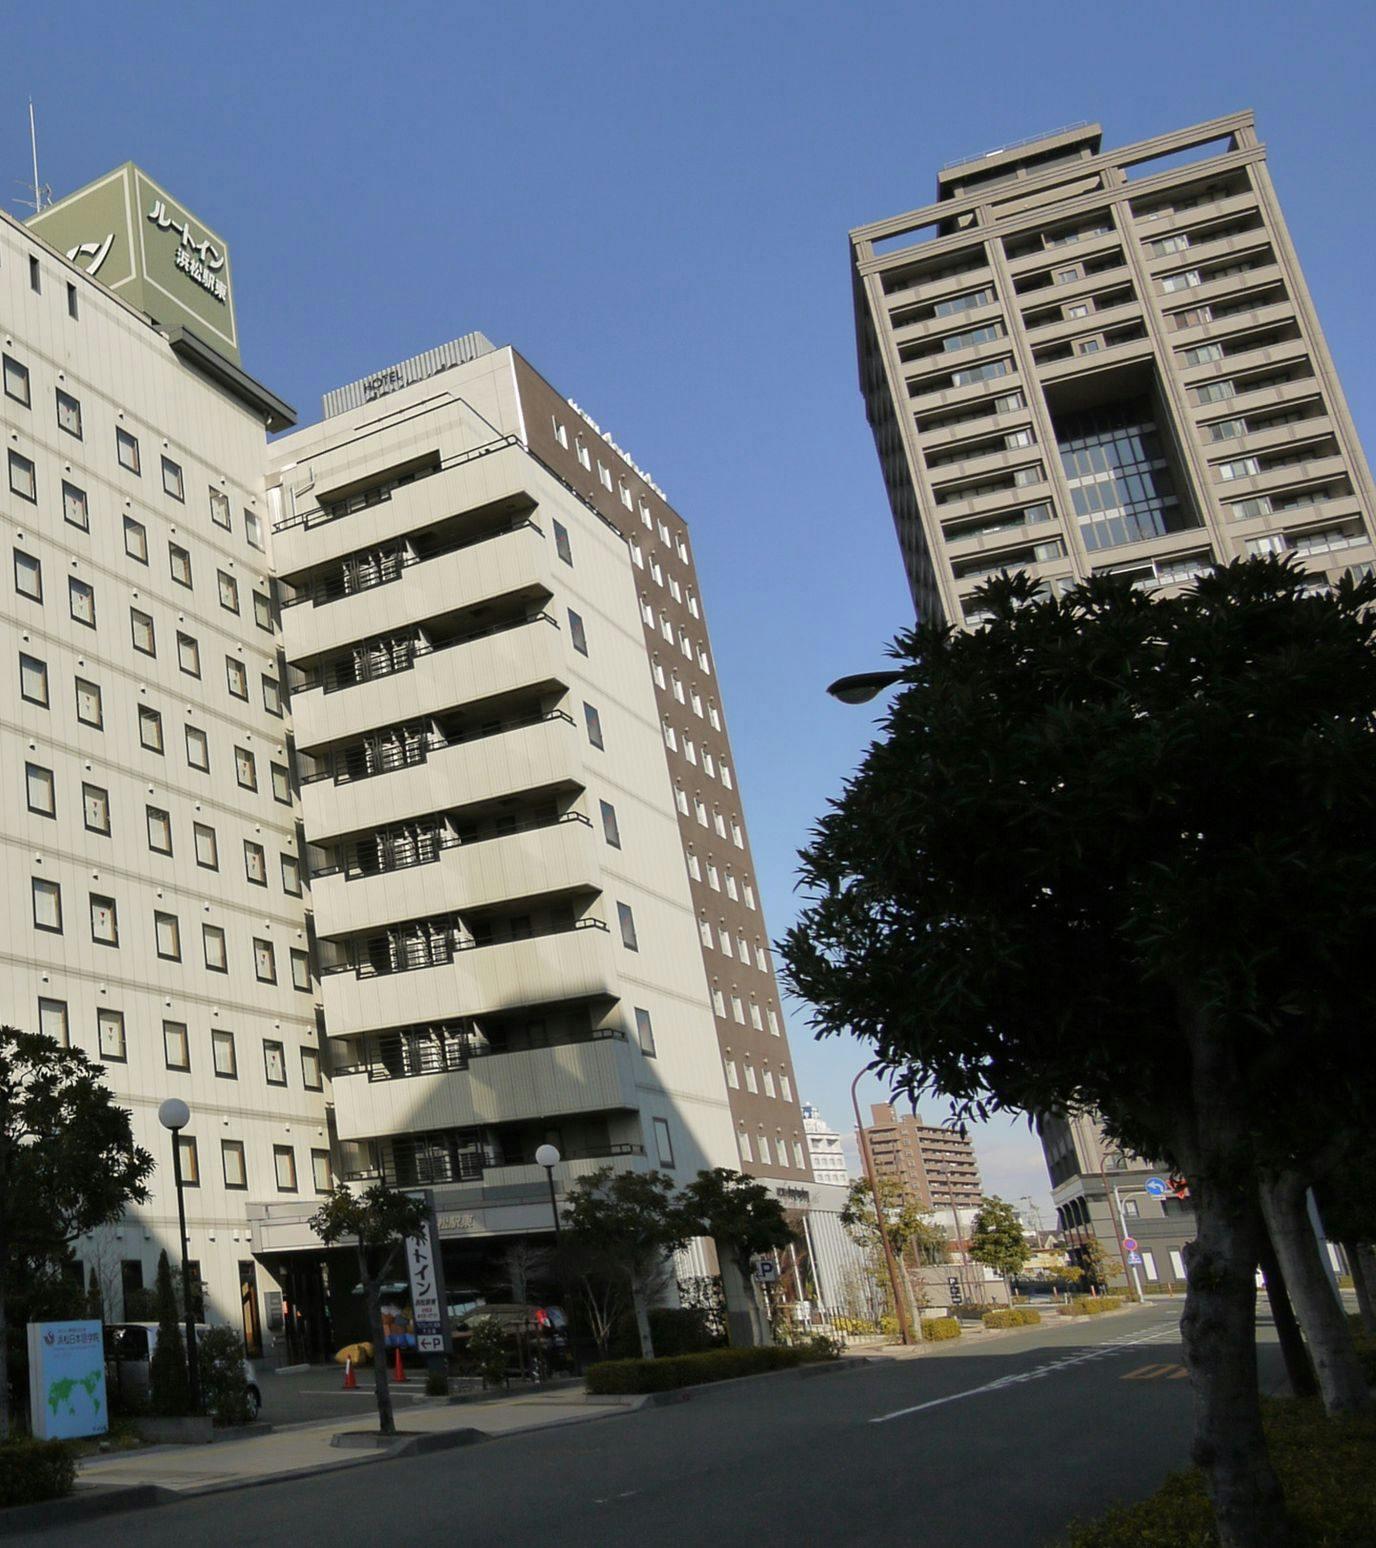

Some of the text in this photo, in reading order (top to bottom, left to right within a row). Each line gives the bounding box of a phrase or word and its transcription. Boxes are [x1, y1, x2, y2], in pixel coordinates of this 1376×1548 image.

[148, 200, 224, 269] ルートイン
[176, 247, 228, 302] 浜松駅東
[363, 370, 403, 394] HOTEL
[761, 1262, 773, 1277] P
[432, 1338, 441, 1349] P
